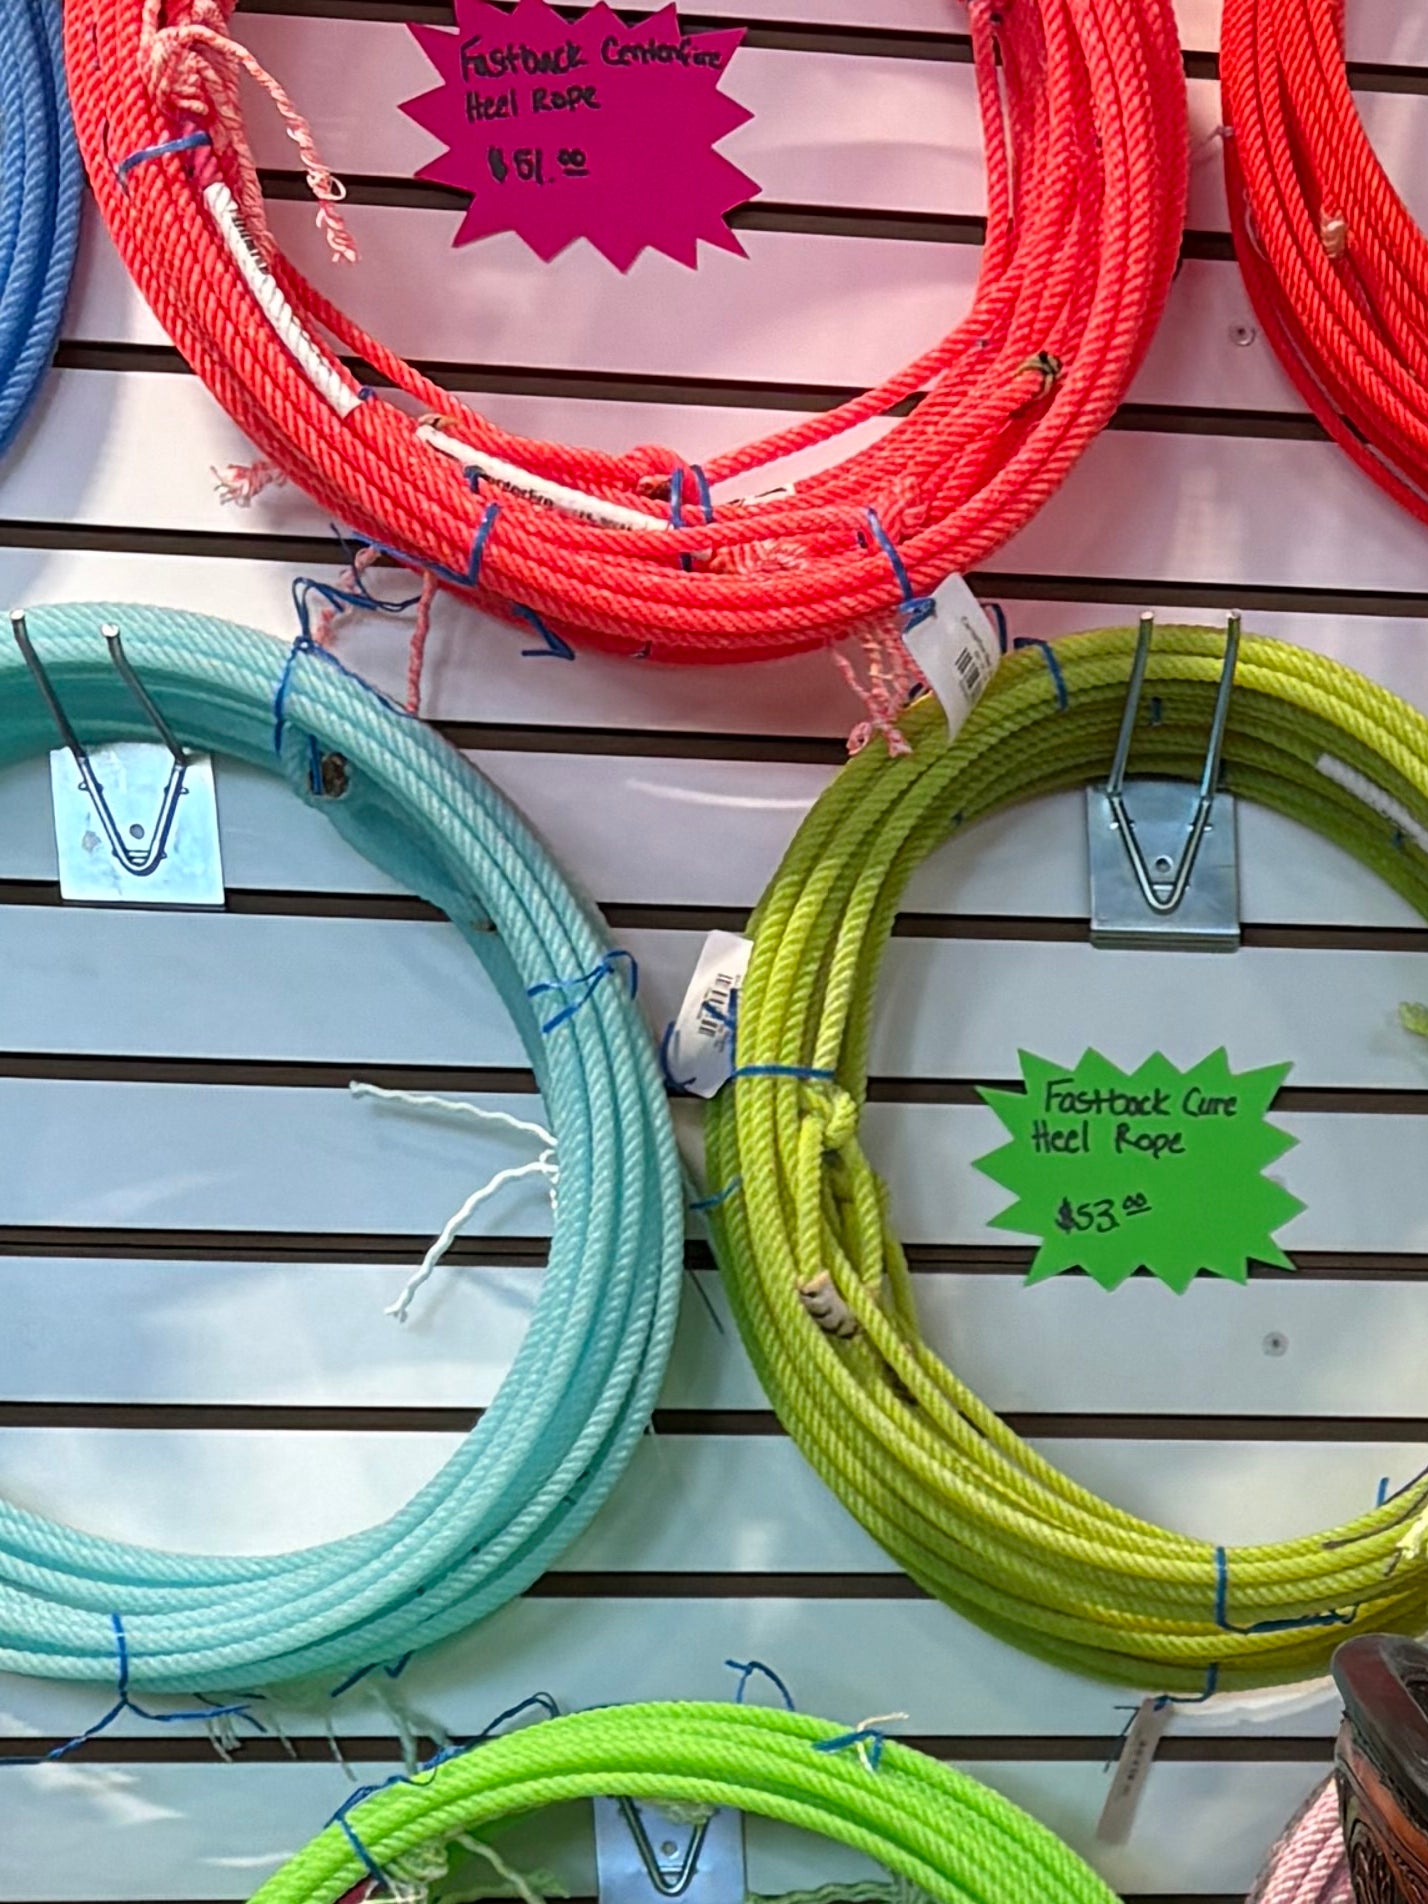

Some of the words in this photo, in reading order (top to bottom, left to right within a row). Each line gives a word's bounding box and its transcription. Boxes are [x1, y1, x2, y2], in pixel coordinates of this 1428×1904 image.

[459, 35, 588, 81] Fastback
[465, 88, 518, 124] Heel
[1045, 1077, 1172, 1116] Fastback
[1182, 1087, 1238, 1117] Cure
[1031, 1120, 1090, 1154] Heel
[1114, 1122, 1187, 1160] Rope
